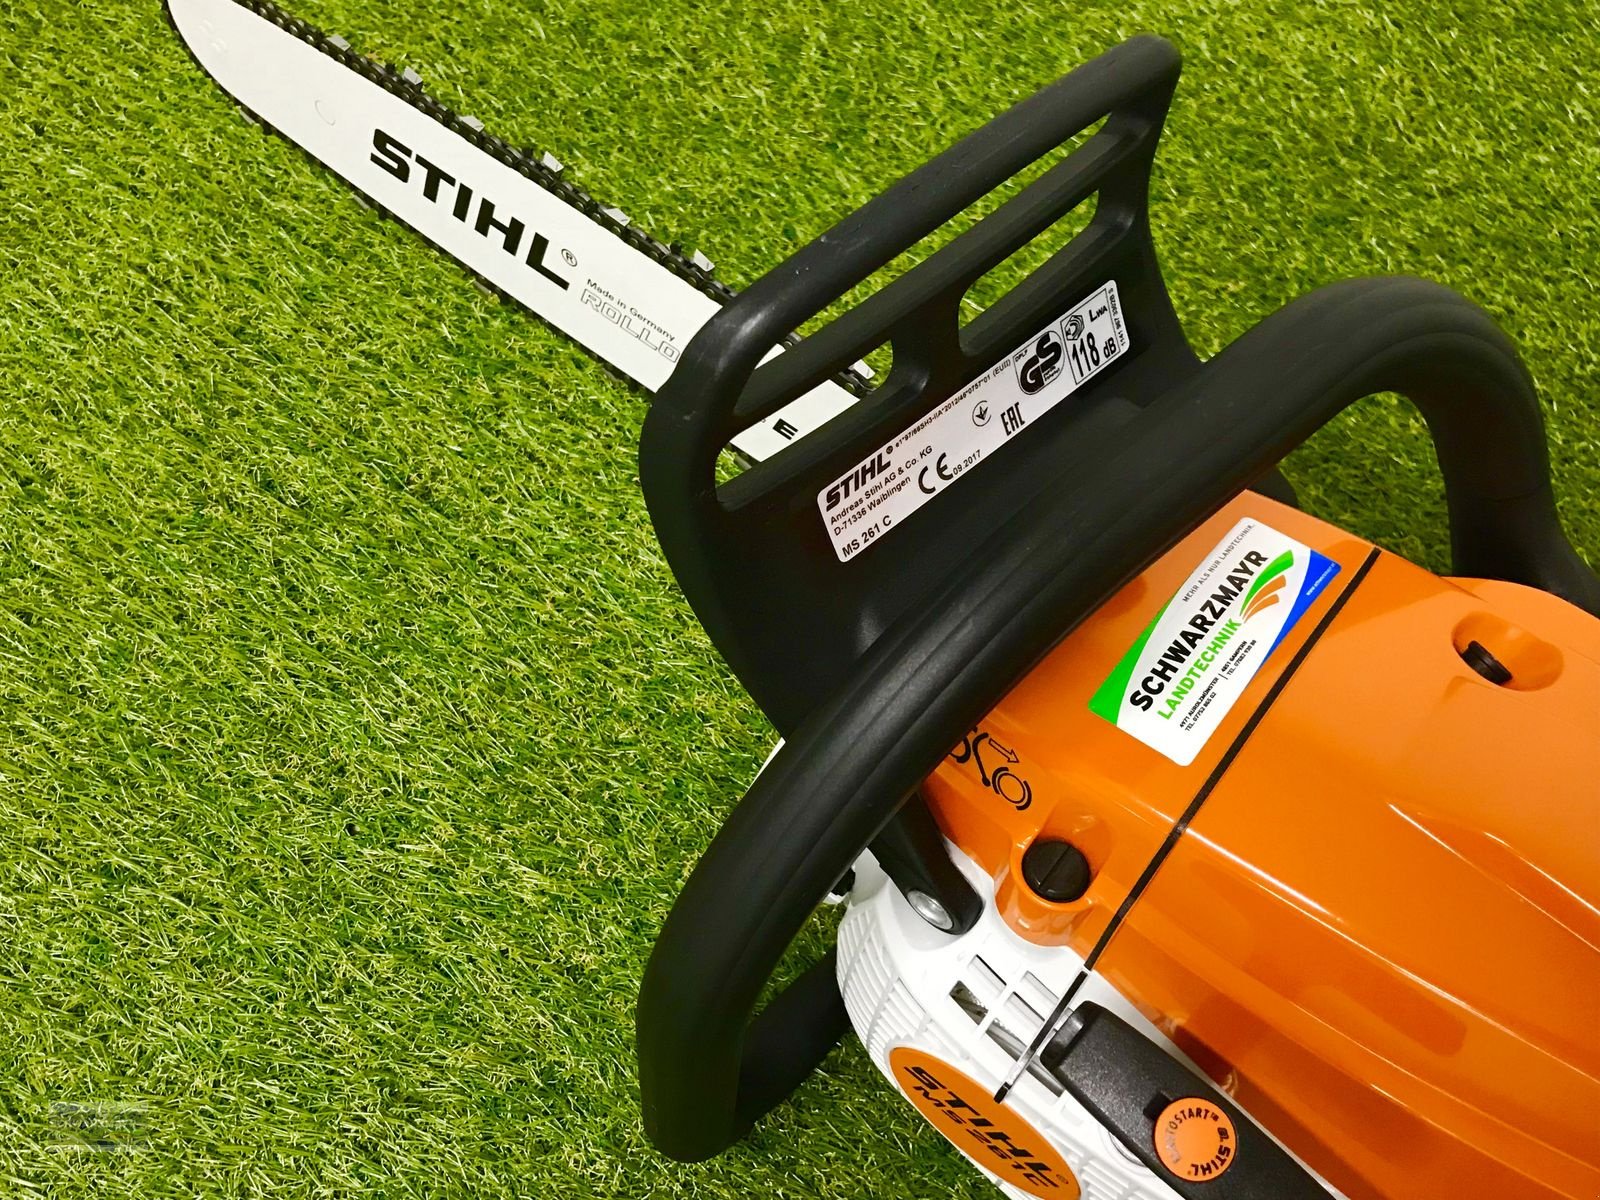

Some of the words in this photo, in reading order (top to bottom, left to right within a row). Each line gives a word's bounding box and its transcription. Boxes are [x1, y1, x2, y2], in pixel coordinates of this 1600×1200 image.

[587, 279, 614, 301] Made
[617, 299, 626, 310] in
[630, 307, 675, 341] Germany
[1020, 331, 1062, 392] GS
[1072, 332, 1100, 378] 118
[1103, 337, 1117, 359] dB
[830, 497, 864, 525] Andreas
[864, 481, 883, 500] Stihl
[884, 472, 897, 486] AG
[897, 467, 904, 476] &
[905, 458, 919, 470] Co.
[919, 445, 933, 459] KG
[918, 452, 953, 494] CE
[953, 449, 981, 475] 09.2017
[834, 508, 867, 536] D-71336
[867, 476, 911, 511] Waiblingen
[842, 539, 860, 558] MS
[861, 523, 881, 544] 261
[883, 515, 892, 527] C
[1182, 584, 1199, 602] MEHR
[1200, 572, 1210, 585] ALS
[1208, 559, 1221, 573] NUR
[1129, 550, 1268, 712] SCHWARZMAYR
[1157, 618, 1242, 720] LANDTECHNIK
